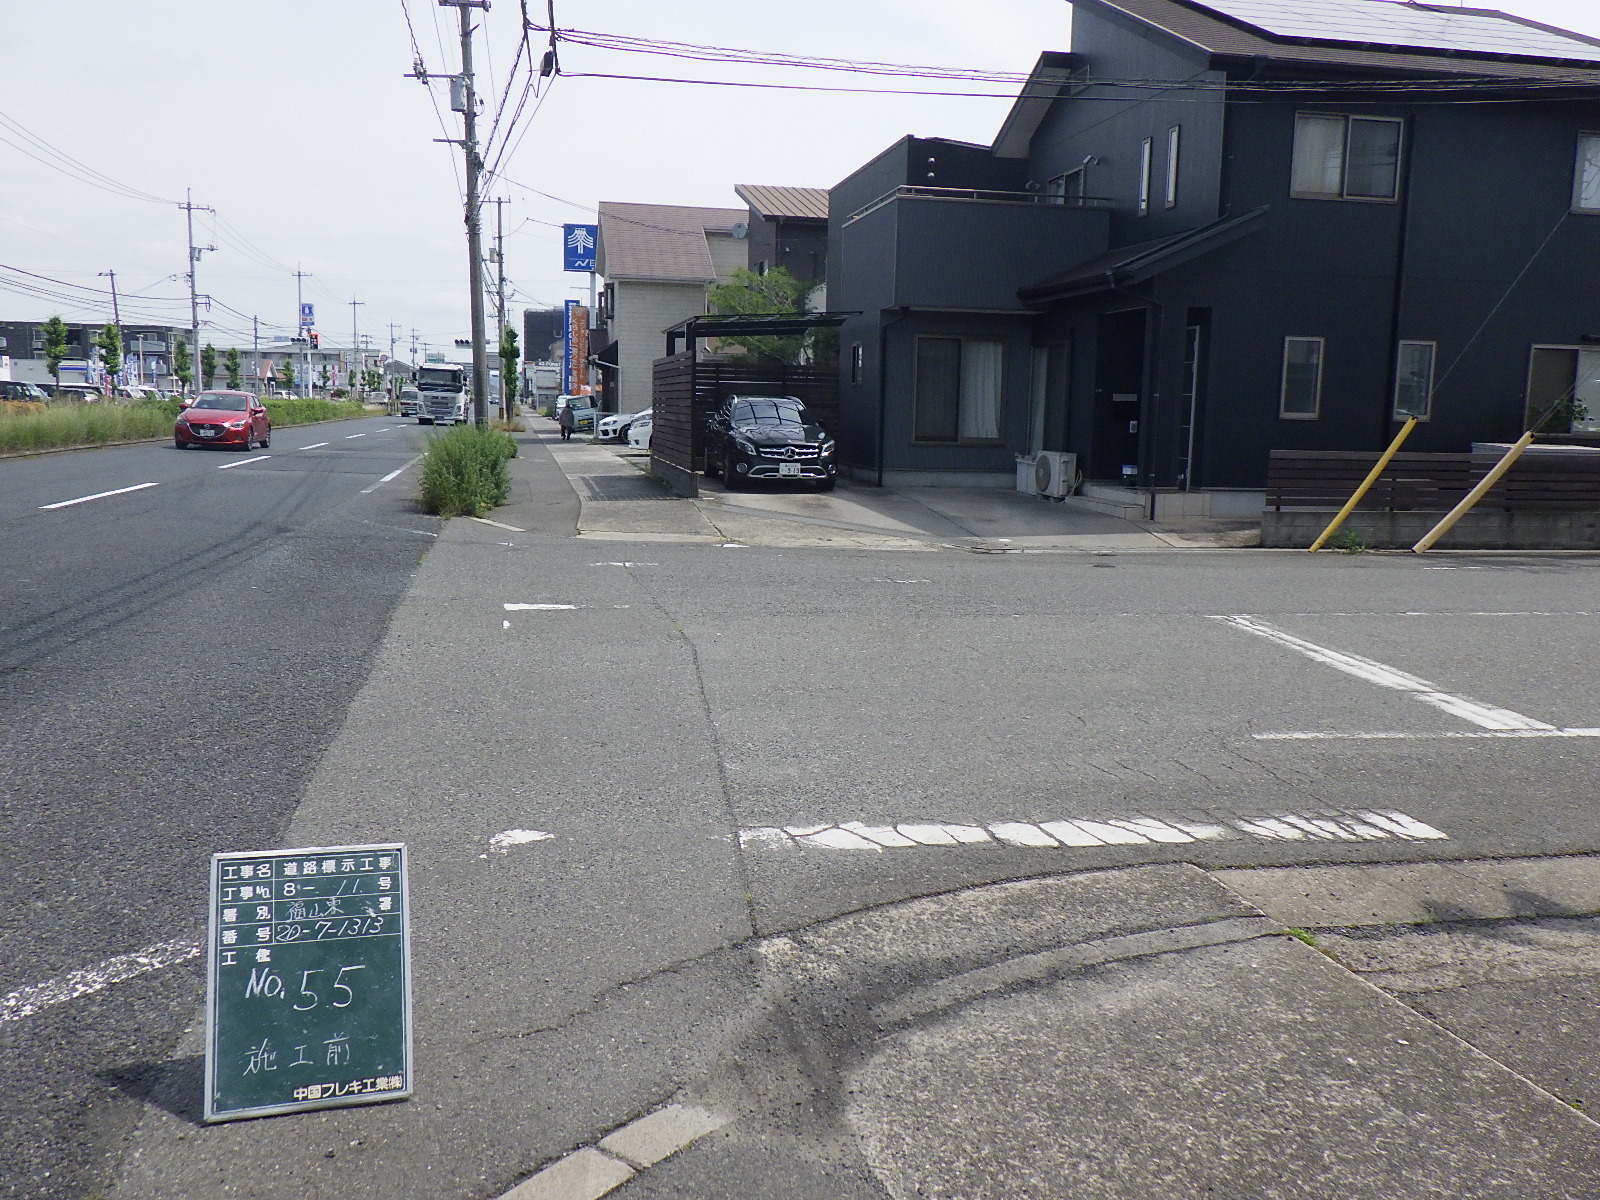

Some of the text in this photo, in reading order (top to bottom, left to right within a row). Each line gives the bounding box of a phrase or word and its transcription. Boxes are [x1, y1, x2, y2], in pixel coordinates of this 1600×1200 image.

[222, 856, 392, 880] 工事名 道路標示工事
